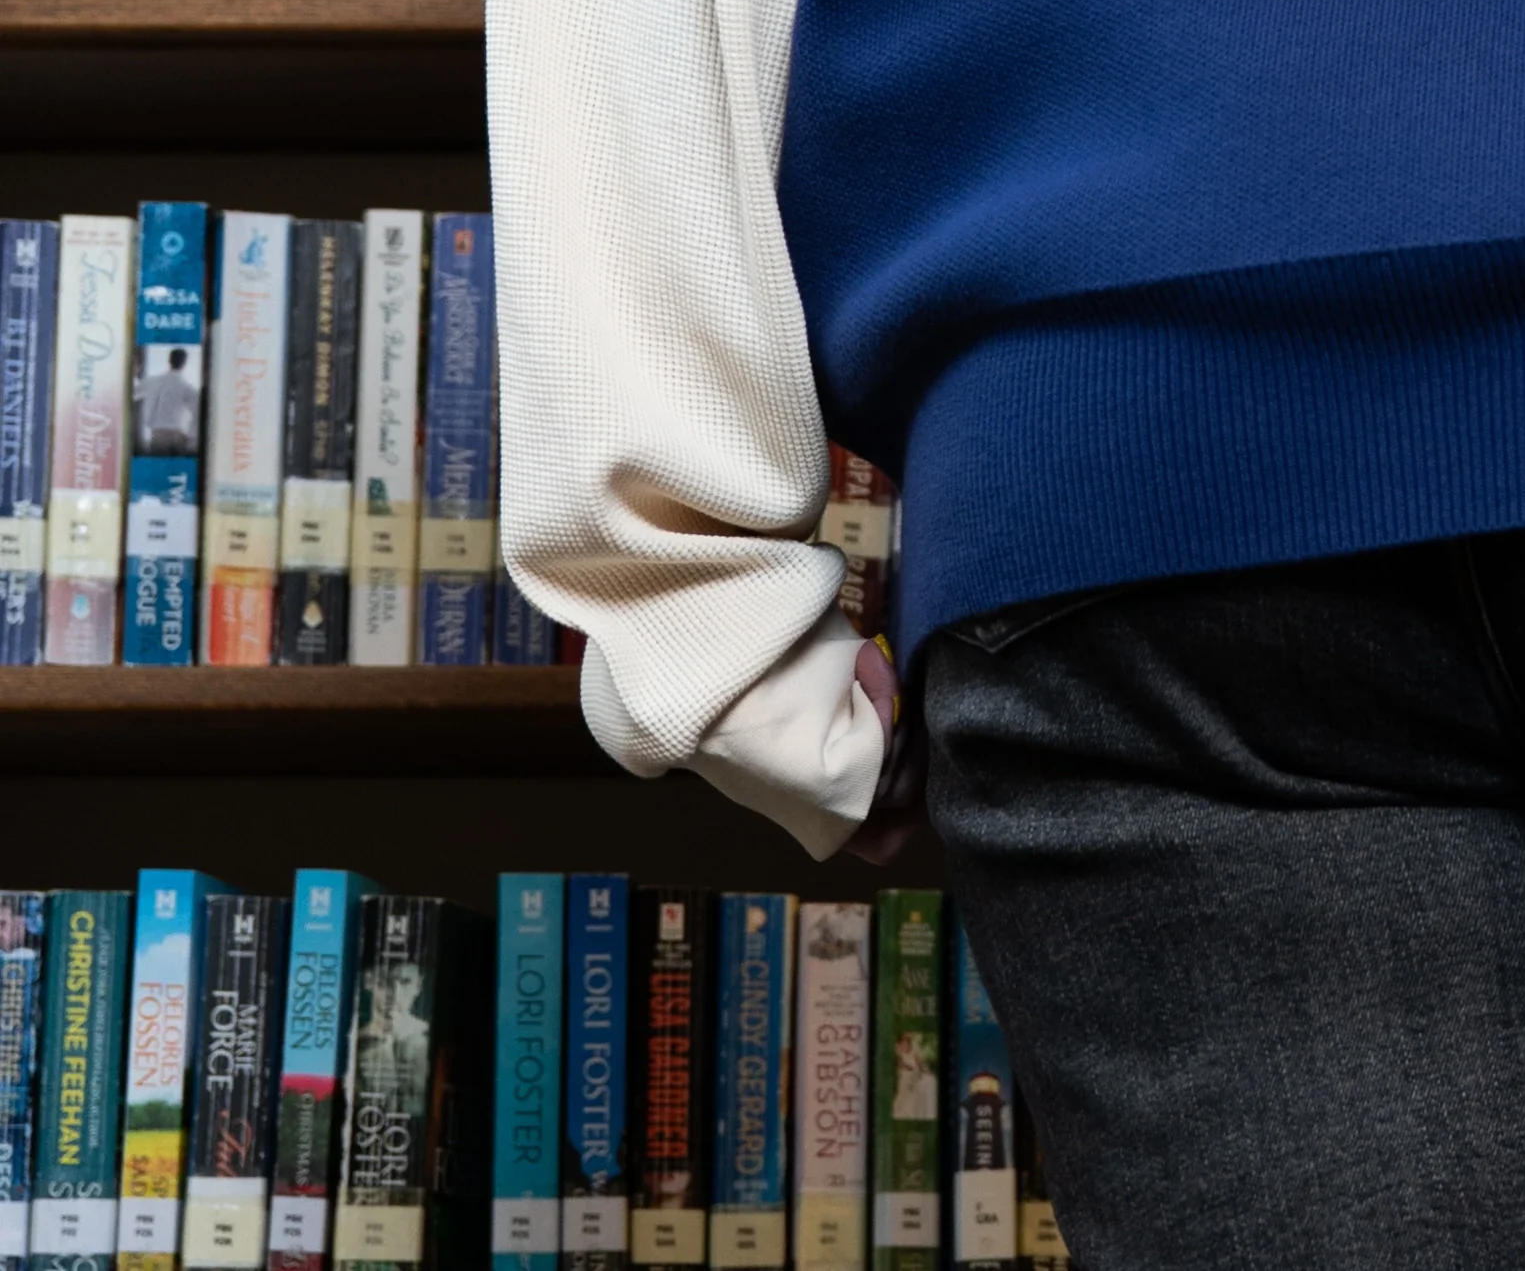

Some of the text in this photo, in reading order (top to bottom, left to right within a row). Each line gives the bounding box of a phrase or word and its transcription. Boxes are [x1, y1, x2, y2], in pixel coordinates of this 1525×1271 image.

[76, 252, 119, 399] Tessa Dare
[143, 289, 199, 306] TESSA
[144, 313, 195, 331] DARE
[315, 236, 337, 406] HELENKAY DIMON
[0, 358, 23, 467] DANIELS
[232, 288, 272, 473] Jude Deveraux
[161, 555, 187, 650] EMPTED
[433, 574, 476, 656] DURAN
[57, 910, 95, 1166] CHRISTINE FEEHAN
[134, 981, 162, 1088] FOSSEN
[160, 982, 185, 1088] DELORES
[207, 989, 238, 1093] FORCE
[235, 1004, 259, 1078] MARIE
[288, 951, 319, 1052] FOSSEN
[314, 952, 339, 1051] DELORES
[512, 953, 545, 1165] LORI FOSTER
[581, 952, 613, 1164] LORI FOSTER
[647, 972, 691, 1159] LISA GARDNER
[735, 959, 770, 1177] CINDY GERARD
[813, 1022, 838, 1160] GIBSON
[837, 1022, 863, 1152] RACHEL
[295, 1091, 314, 1185] CHRISTMAS
[353, 1091, 386, 1206] FOSTER
[382, 1111, 412, 1188] LORI
[974, 1103, 994, 1170] SEEIN
